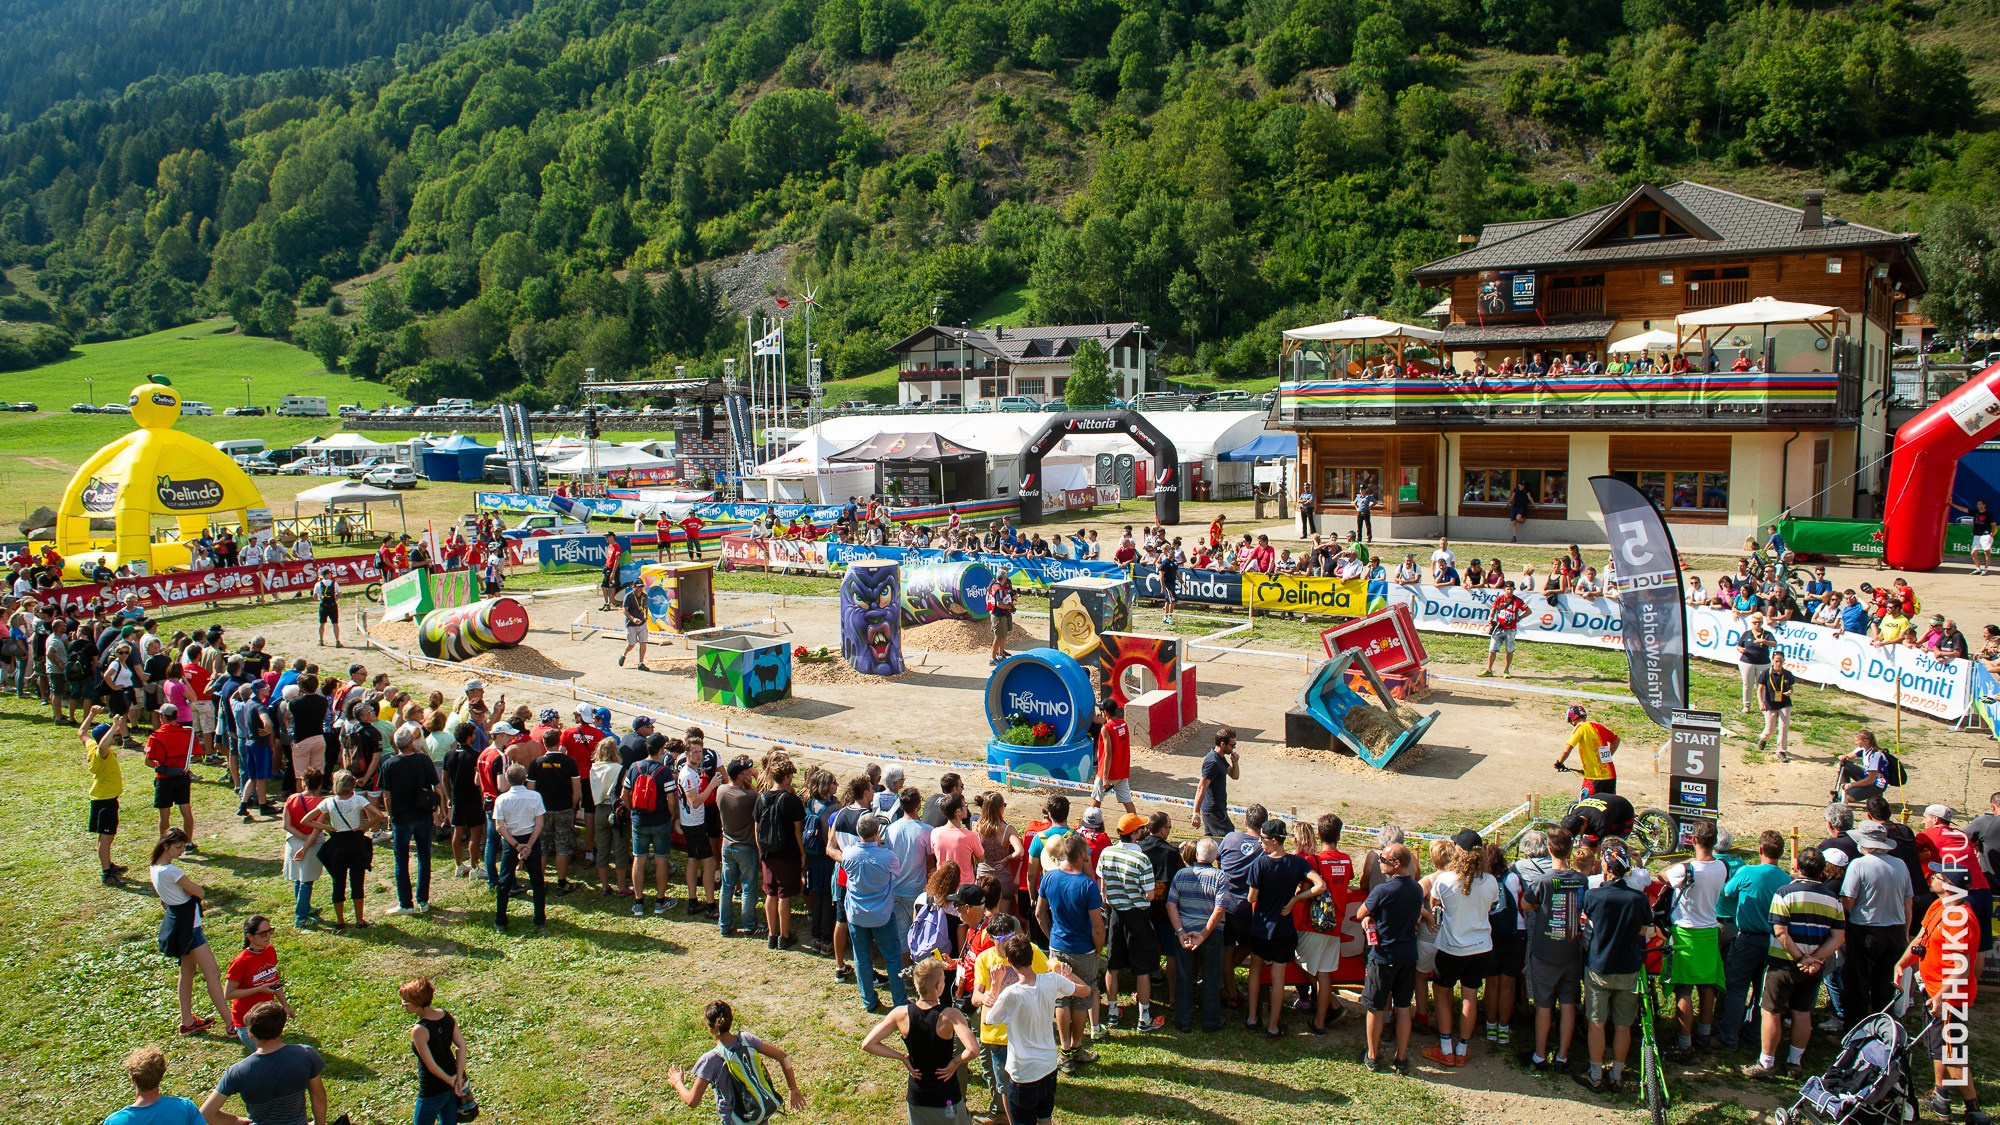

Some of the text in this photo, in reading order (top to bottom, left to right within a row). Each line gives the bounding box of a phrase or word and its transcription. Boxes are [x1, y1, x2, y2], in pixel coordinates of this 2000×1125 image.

[1515, 283, 1533, 291] 2017
[1077, 418, 1116, 430] vittoria
[160, 483, 221, 502] Melinda
[551, 542, 609, 562] TRENTIN
[1853, 543, 1884, 553] Heine
[256, 562, 349, 591] Val di Sle
[1041, 562, 1091, 581] TRENTINO
[153, 572, 253, 603] Val di Sole
[1257, 579, 1350, 608] Melinda
[1471, 590, 1500, 605] Hyd
[1424, 600, 1490, 620] Dolom
[1451, 620, 1492, 634] energ
[1572, 612, 1623, 632] Dolo
[1370, 637, 1401, 654] Sole
[1726, 630, 1812, 662] Dmiti
[1868, 659, 1954, 699] Dolomiti
[1009, 692, 1069, 717] TRENTINO
[1674, 732, 1717, 746] START
[1685, 750, 1704, 775] 5
